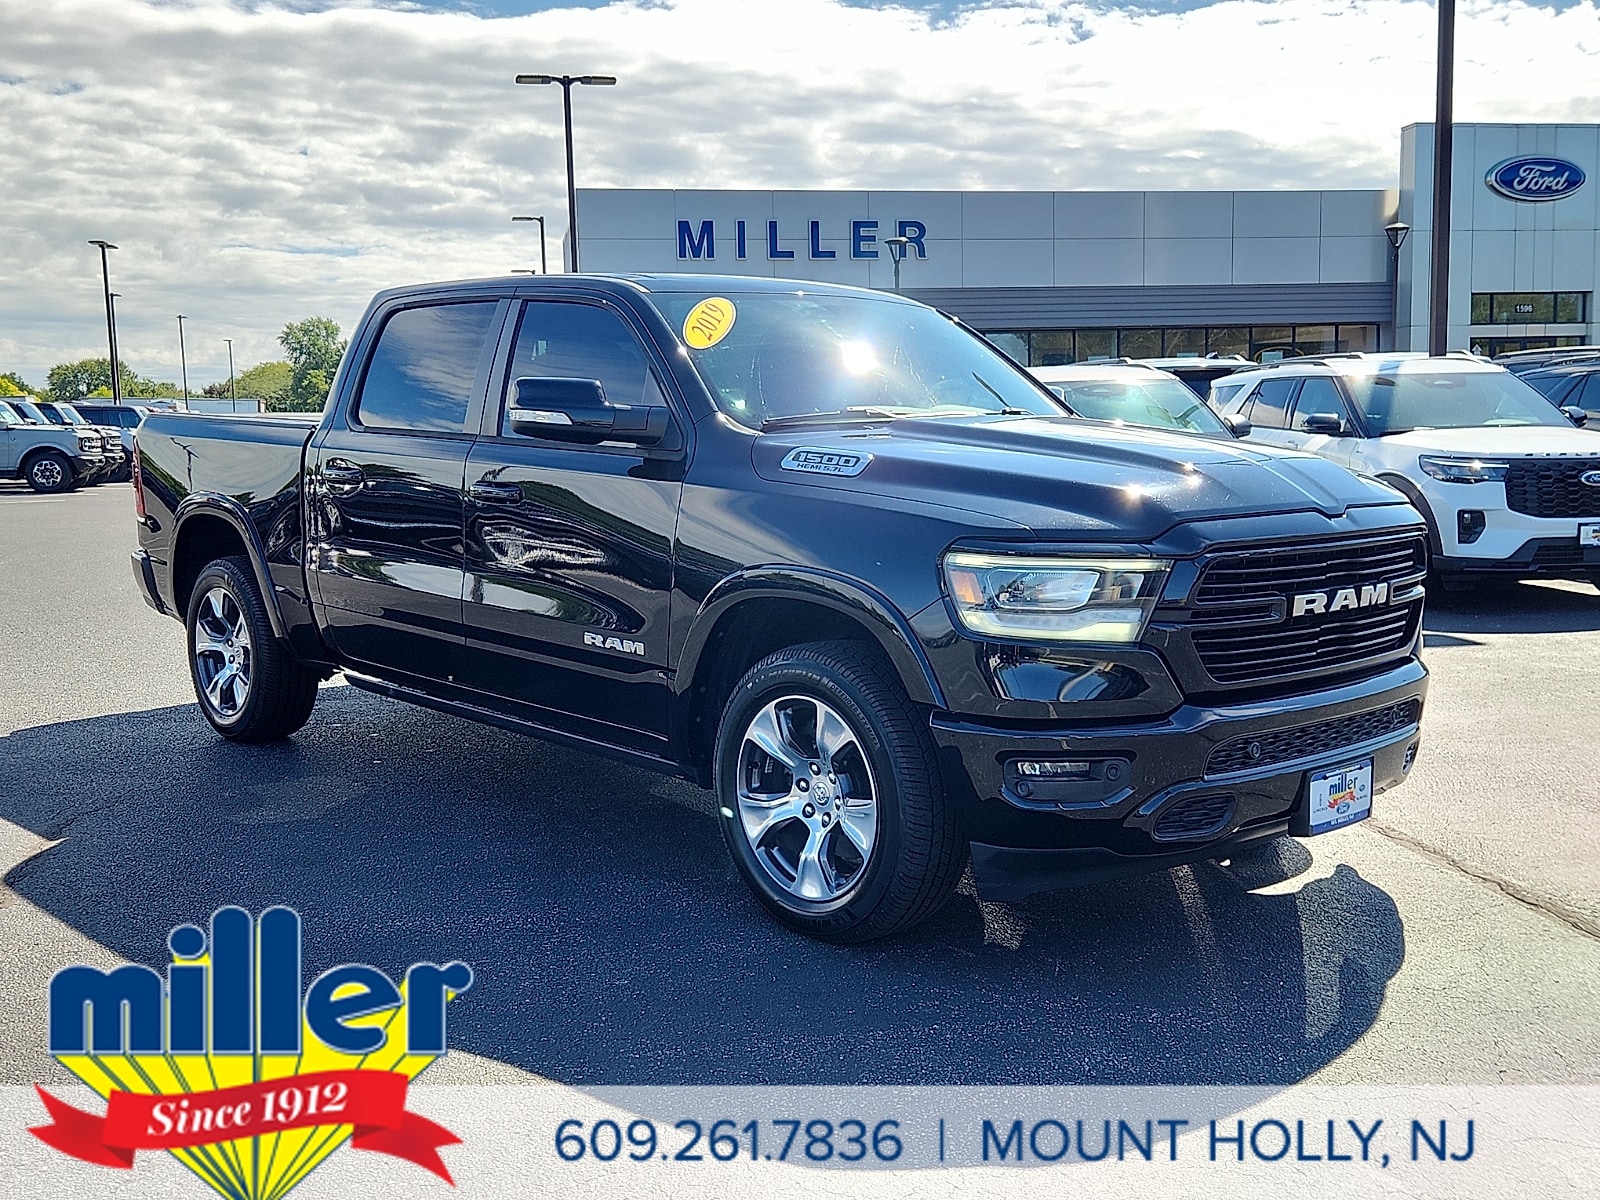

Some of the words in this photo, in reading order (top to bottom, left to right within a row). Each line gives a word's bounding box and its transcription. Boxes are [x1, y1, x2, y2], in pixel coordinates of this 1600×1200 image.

[1513, 165, 1570, 190] Ford
[676, 219, 928, 260] MILLER
[691, 303, 725, 342] 2019
[796, 463, 820, 471] HEMI
[822, 465, 844, 473] 5.7L
[797, 451, 858, 467] 1500
[1292, 582, 1388, 617] RAM
[583, 631, 645, 656] RAM
[1329, 772, 1358, 796] miller
